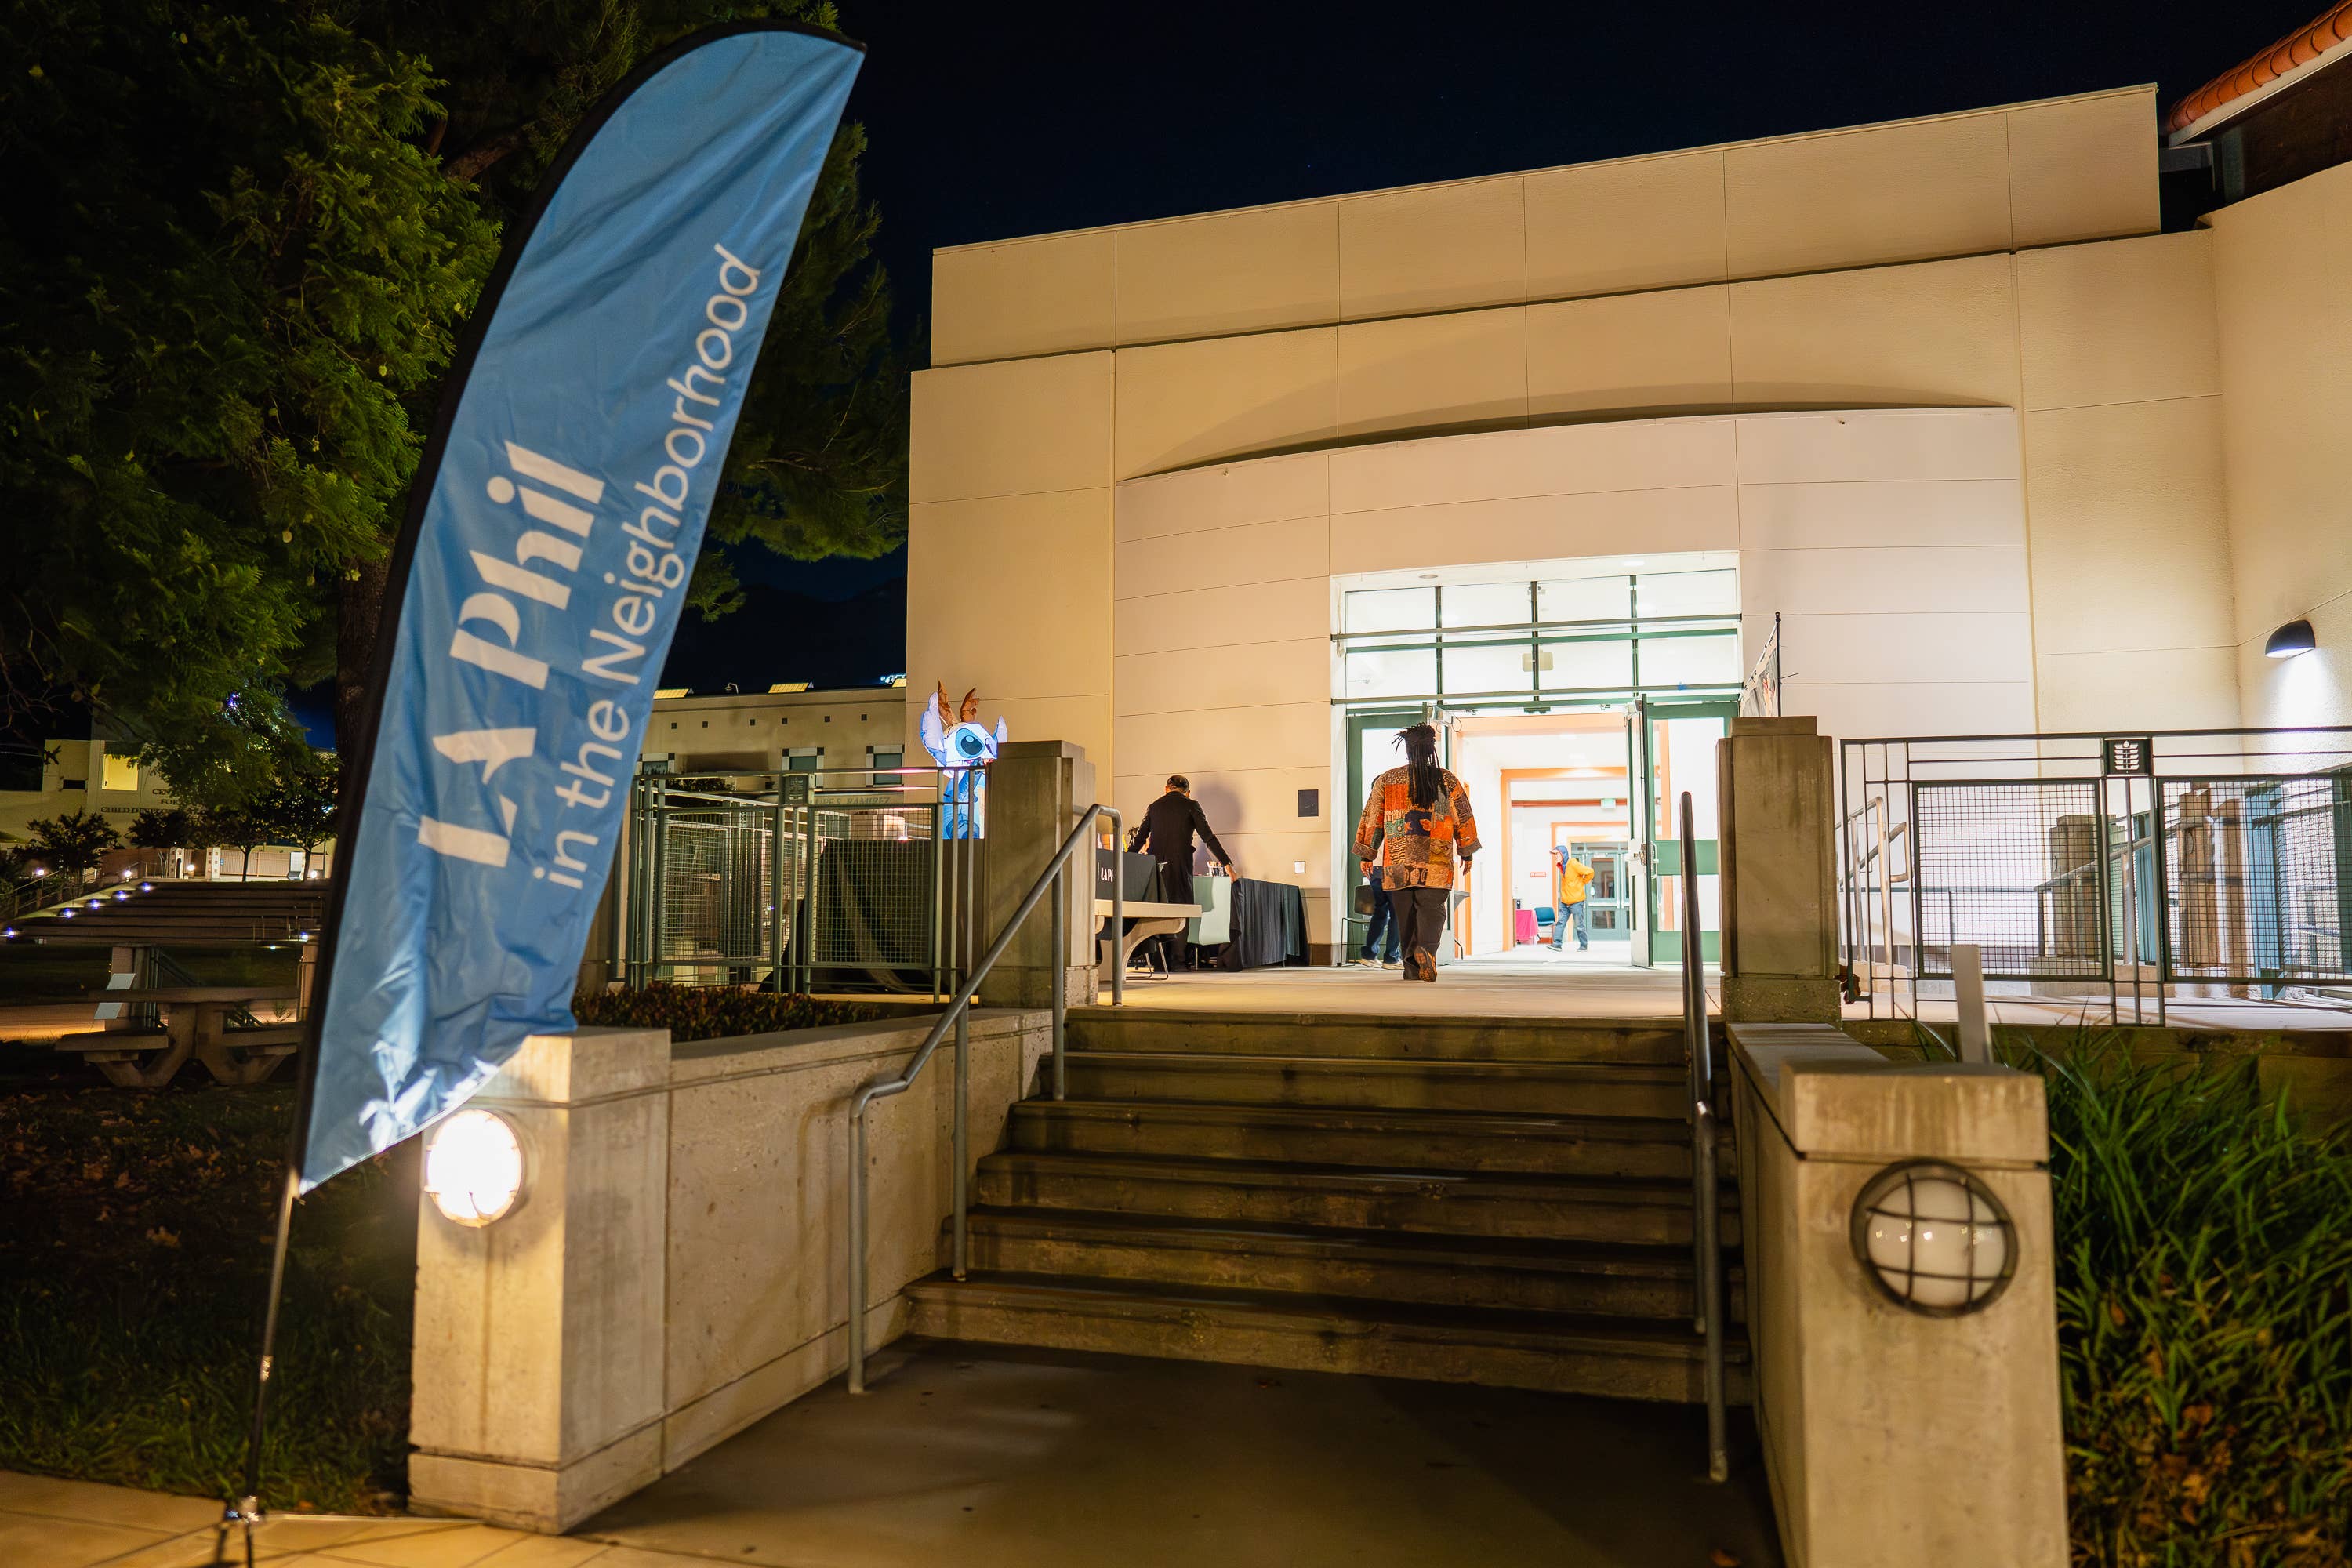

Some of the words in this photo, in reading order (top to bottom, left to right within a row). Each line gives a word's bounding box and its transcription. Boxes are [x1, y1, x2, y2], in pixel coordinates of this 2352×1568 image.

[580, 243, 760, 685] Neighborhood
[449, 441, 605, 690] Phil
[418, 727, 536, 868] LA
[554, 700, 630, 809] the
[533, 829, 599, 891] in
